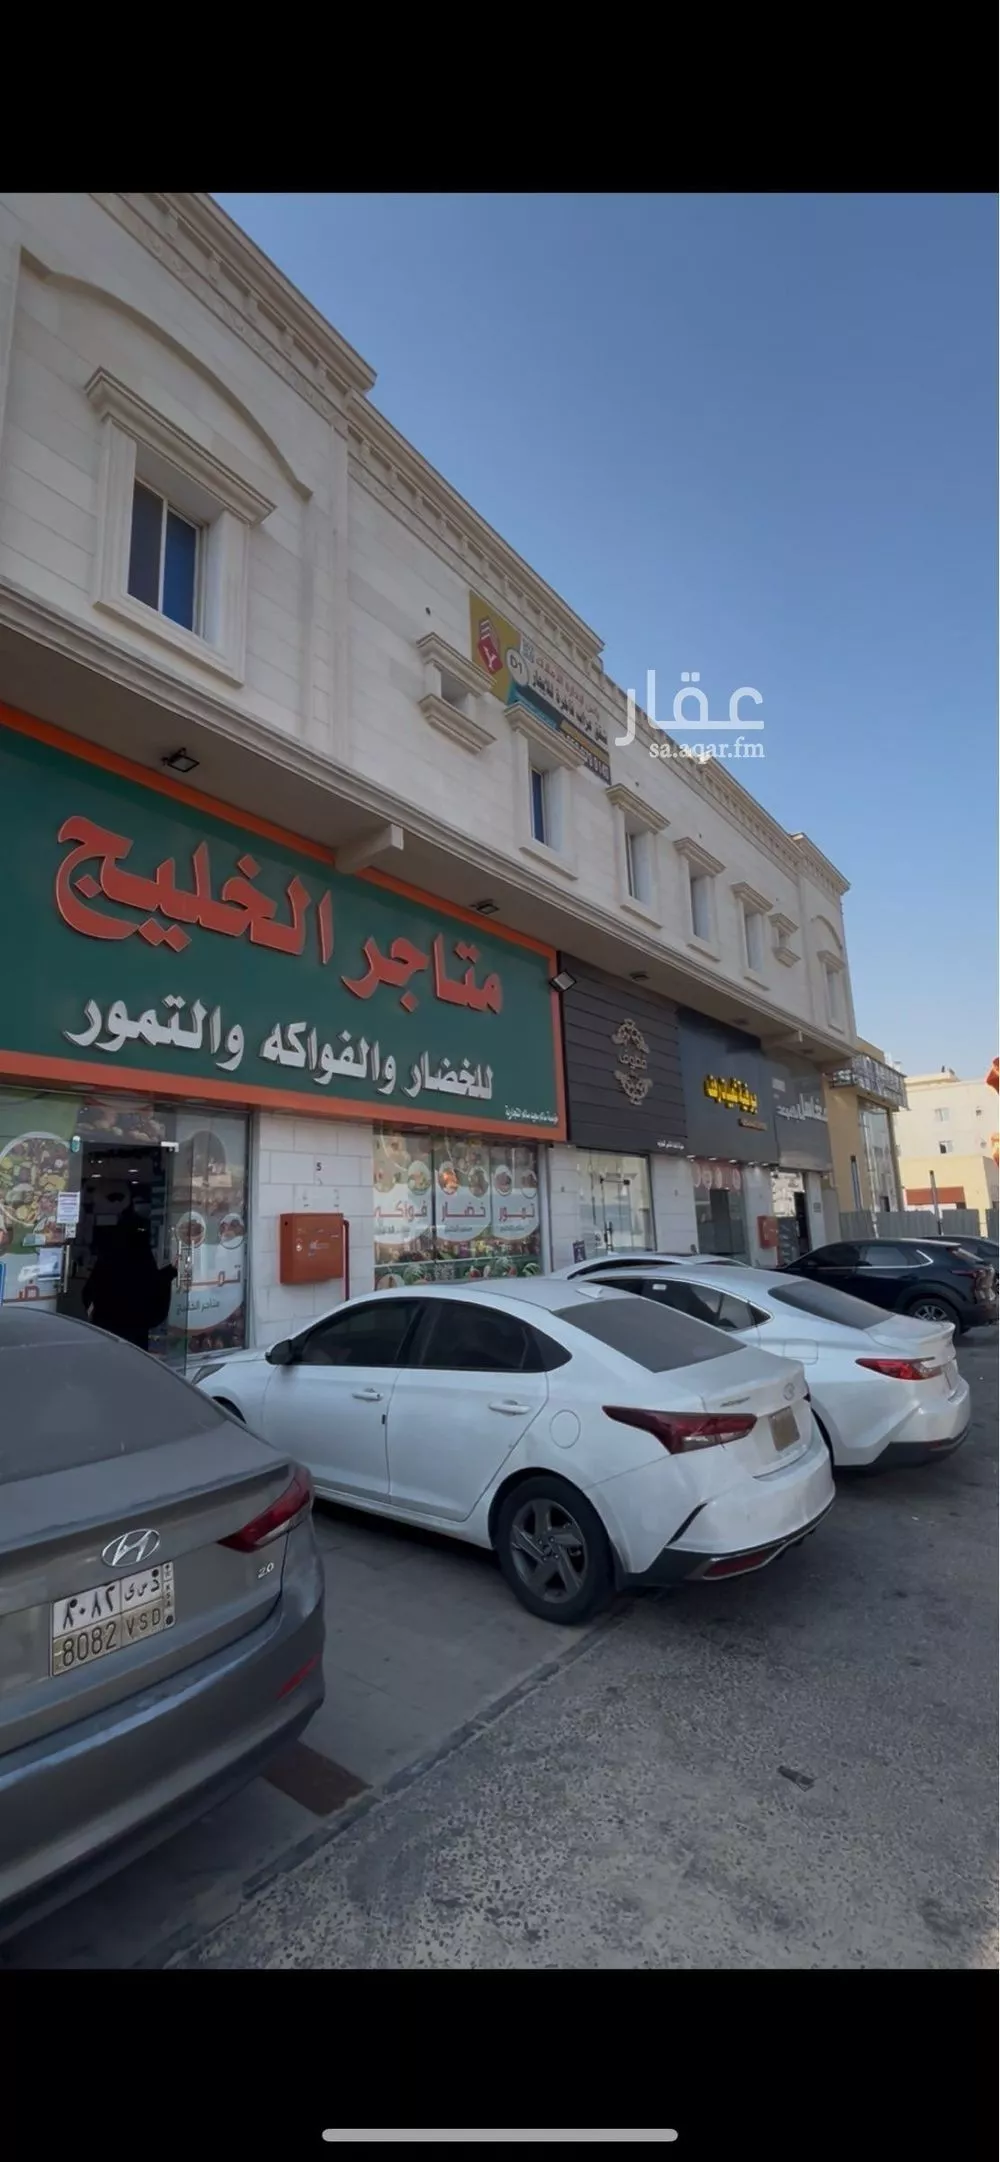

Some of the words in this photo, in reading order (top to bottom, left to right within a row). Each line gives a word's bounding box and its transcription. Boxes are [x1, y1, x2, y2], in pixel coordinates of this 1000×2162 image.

[55, 815, 334, 966] الخليج
[341, 932, 503, 1014] متاجر
[62, 993, 246, 1072] والتمور
[259, 1021, 397, 1096] والفواكه
[403, 1051, 494, 1101] للخضار
[441, 1201, 486, 1222] خضار
[62, 1620, 117, 1667] 8082
[126, 1608, 161, 1637] VSD
